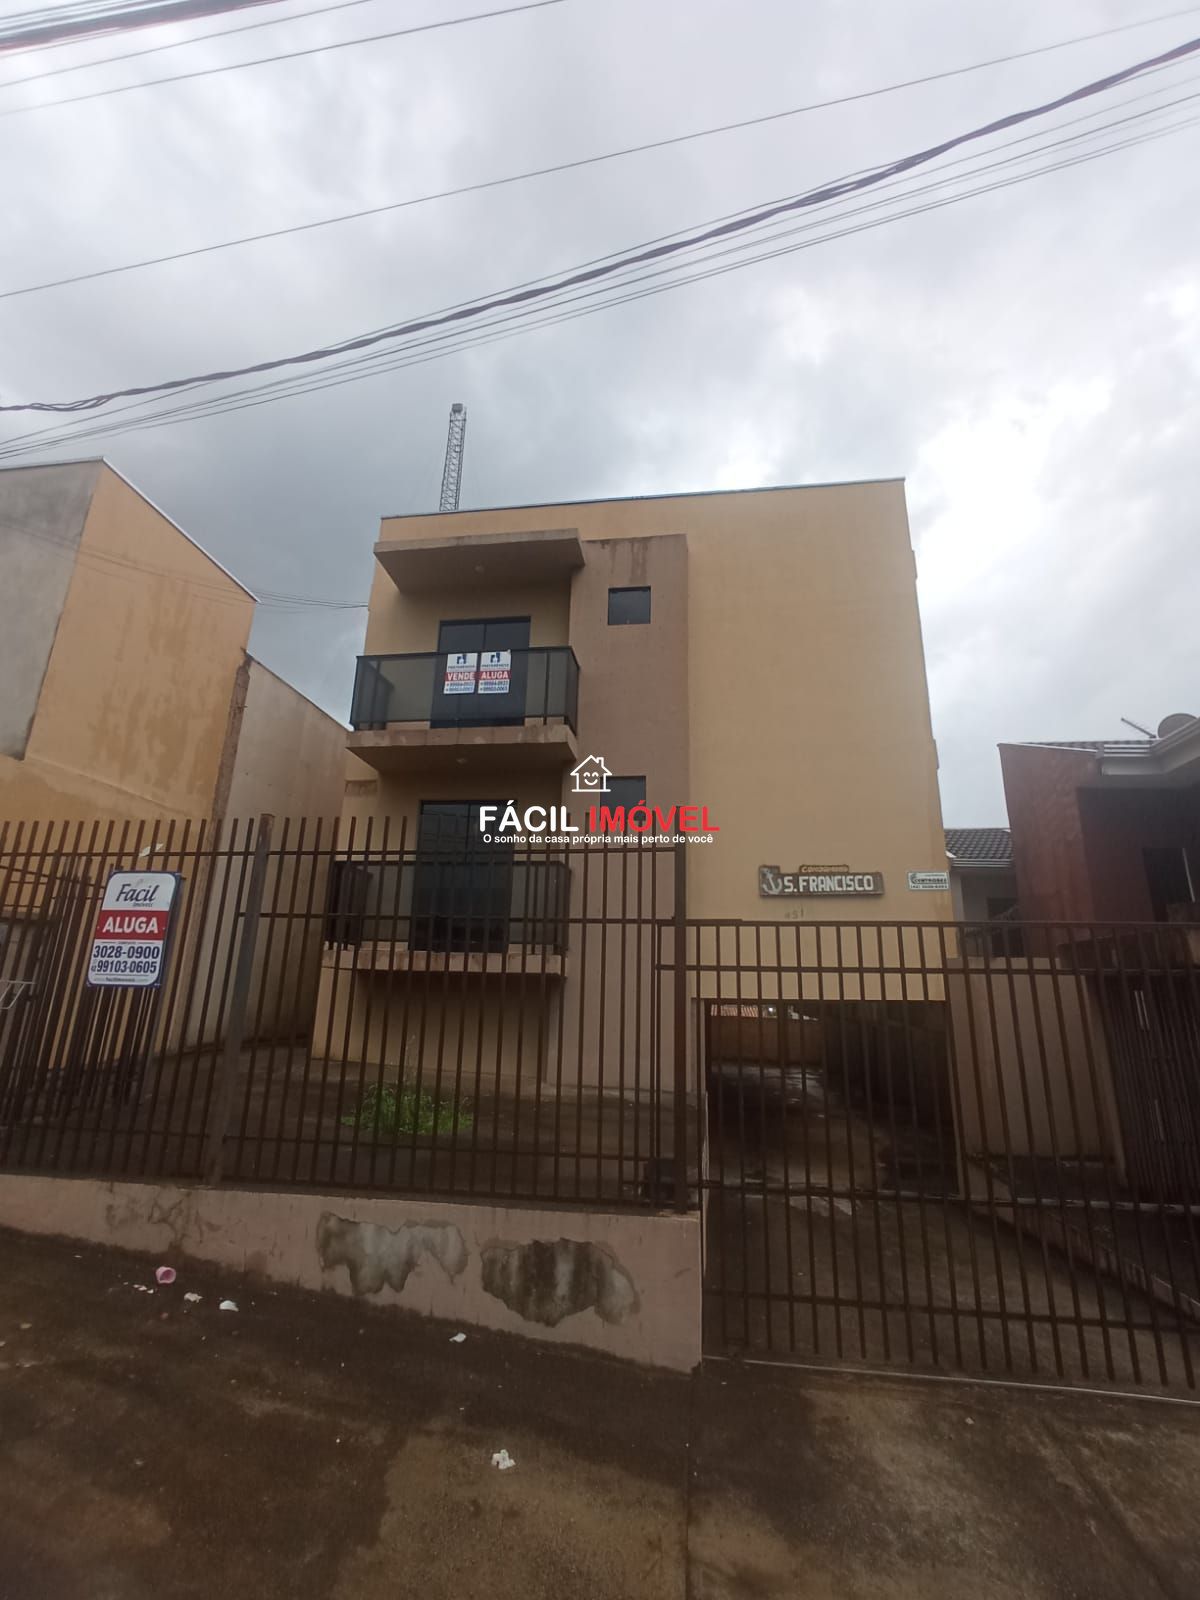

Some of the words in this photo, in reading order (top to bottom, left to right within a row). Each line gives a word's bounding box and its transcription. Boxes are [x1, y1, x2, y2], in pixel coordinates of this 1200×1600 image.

[447, 672, 476, 681] VENDE
[481, 671, 509, 680] ALUGA
[102, 917, 159, 933] ALUGA
[93, 945, 160, 959] 3028-0900
